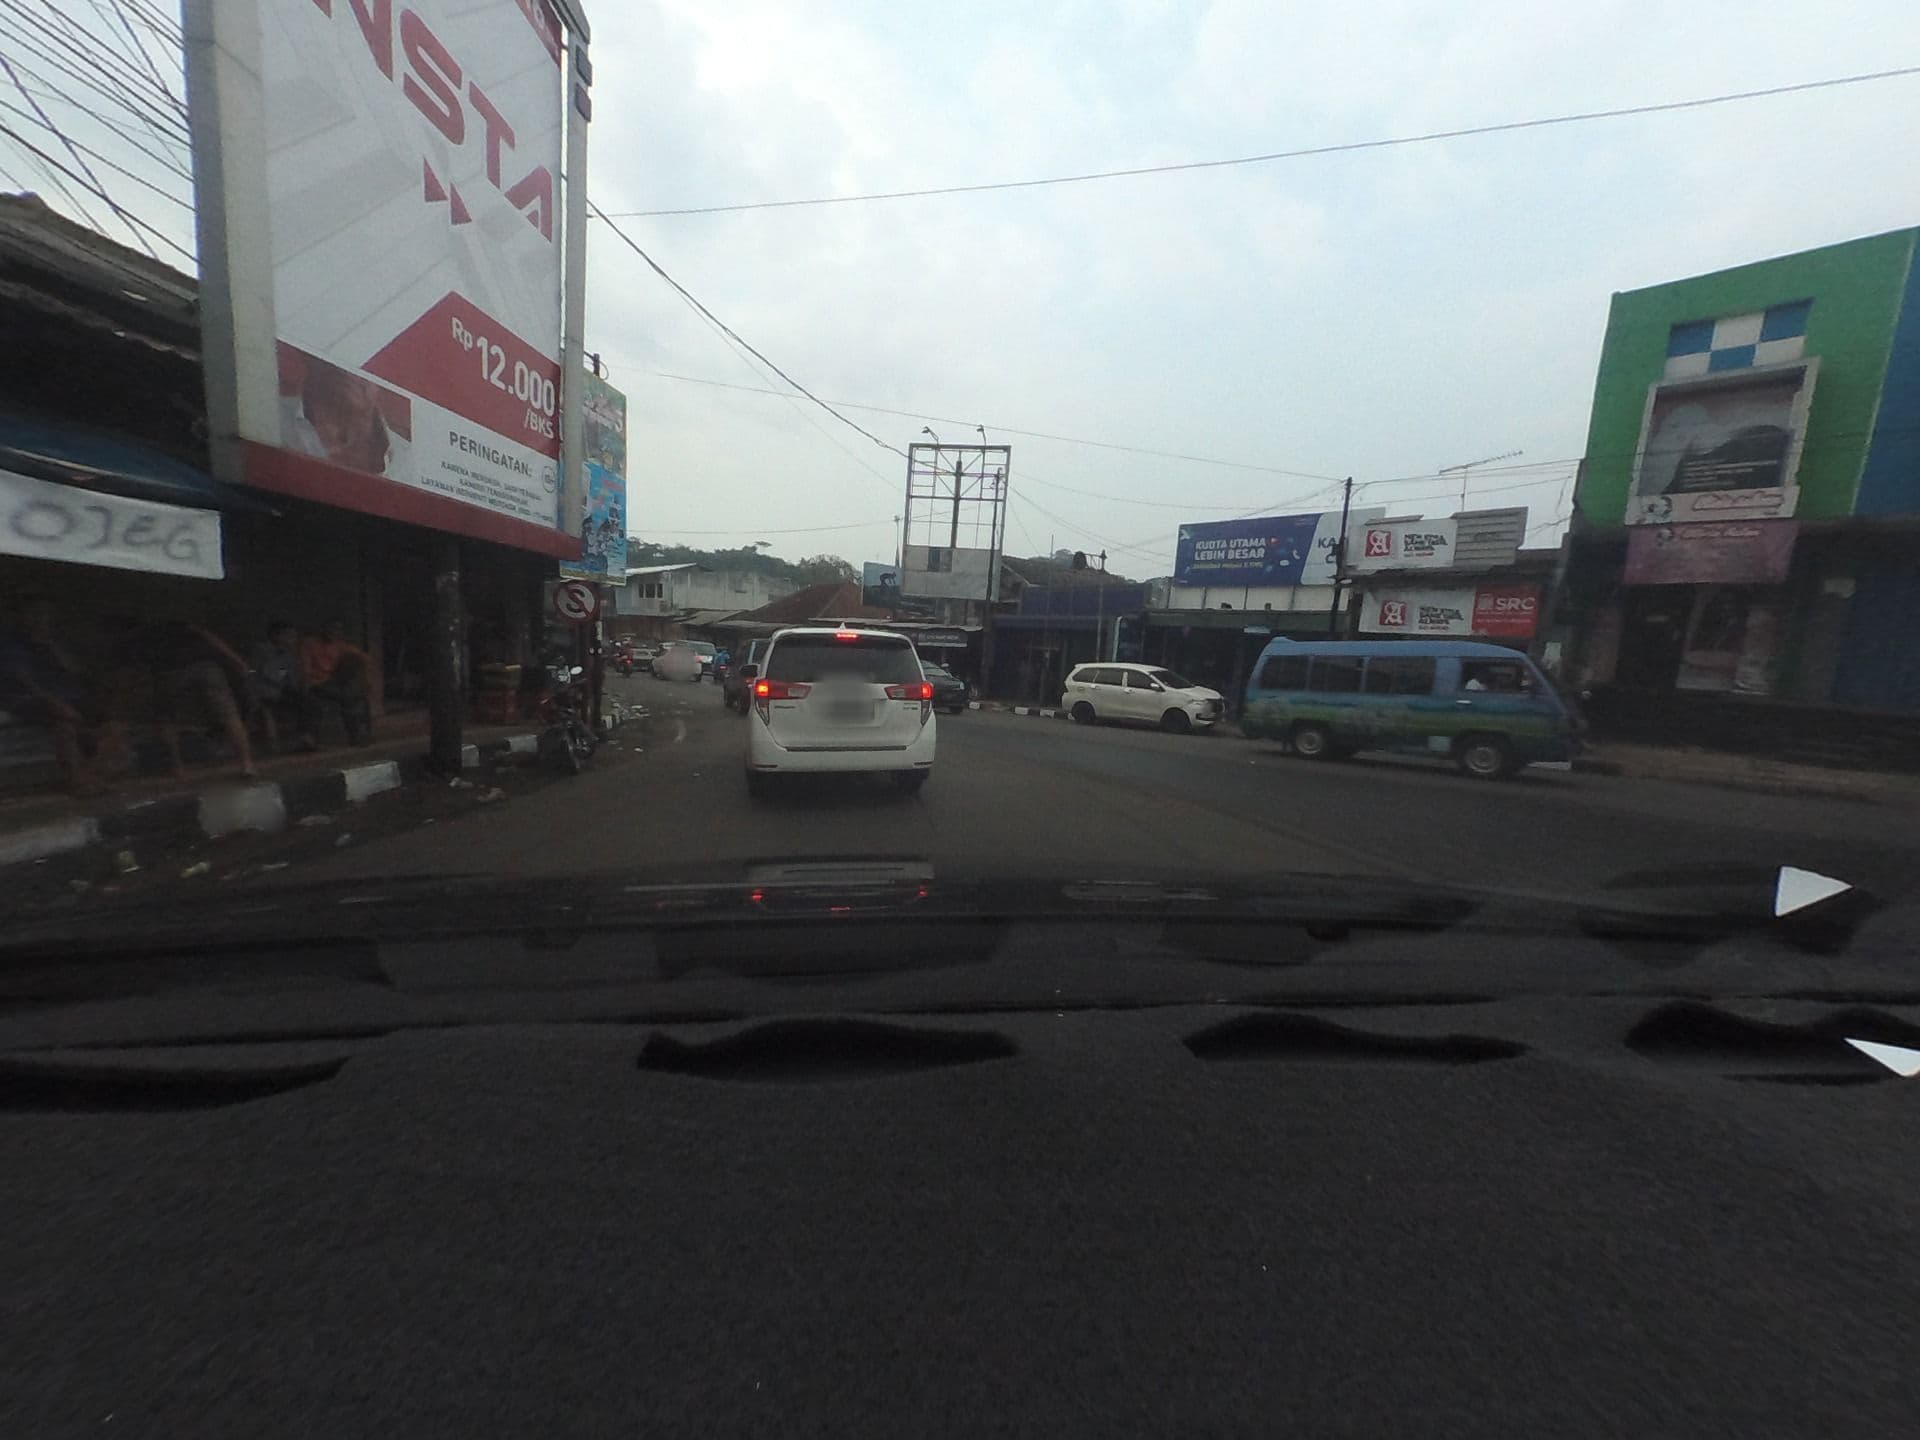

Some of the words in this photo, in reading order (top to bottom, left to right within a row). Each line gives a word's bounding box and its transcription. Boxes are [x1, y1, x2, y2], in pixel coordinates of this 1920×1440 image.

[451, 317, 473, 351] Rp
[476, 336, 556, 417] 12.000
[523, 408, 555, 439] /BKS
[448, 431, 532, 477] PERINGATAN:
[1194, 550, 1225, 561] LEBIH
[1227, 548, 1265, 560] BESAR
[1195, 540, 1227, 550] KUOTA
[1229, 537, 1266, 548] UTAMA
[1496, 597, 1536, 610] SRC
